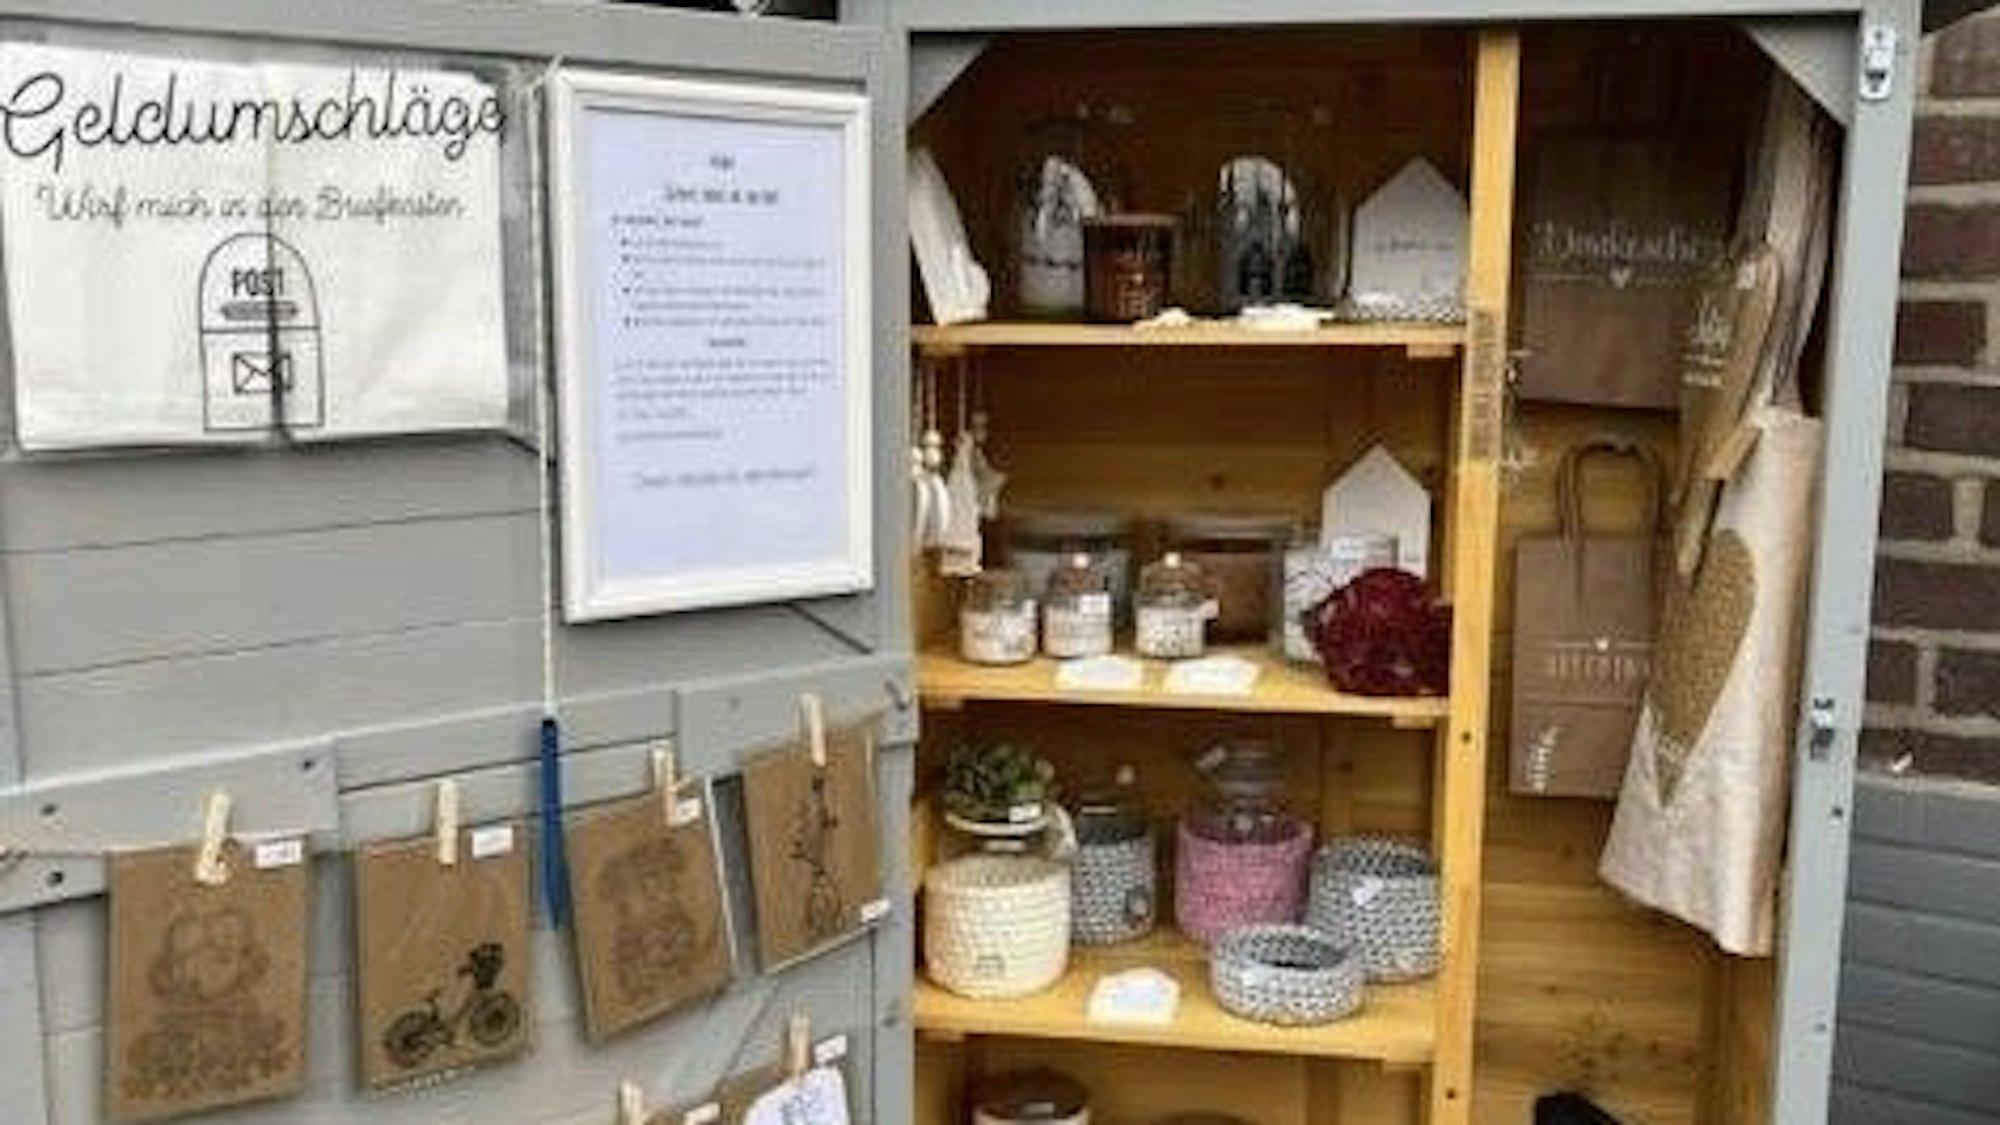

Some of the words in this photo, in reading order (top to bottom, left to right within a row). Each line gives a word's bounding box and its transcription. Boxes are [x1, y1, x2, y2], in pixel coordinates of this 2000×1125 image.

[0, 70, 506, 174] Geldumschläge
[36, 184, 127, 229] Wirf
[232, 266, 284, 296] POST
